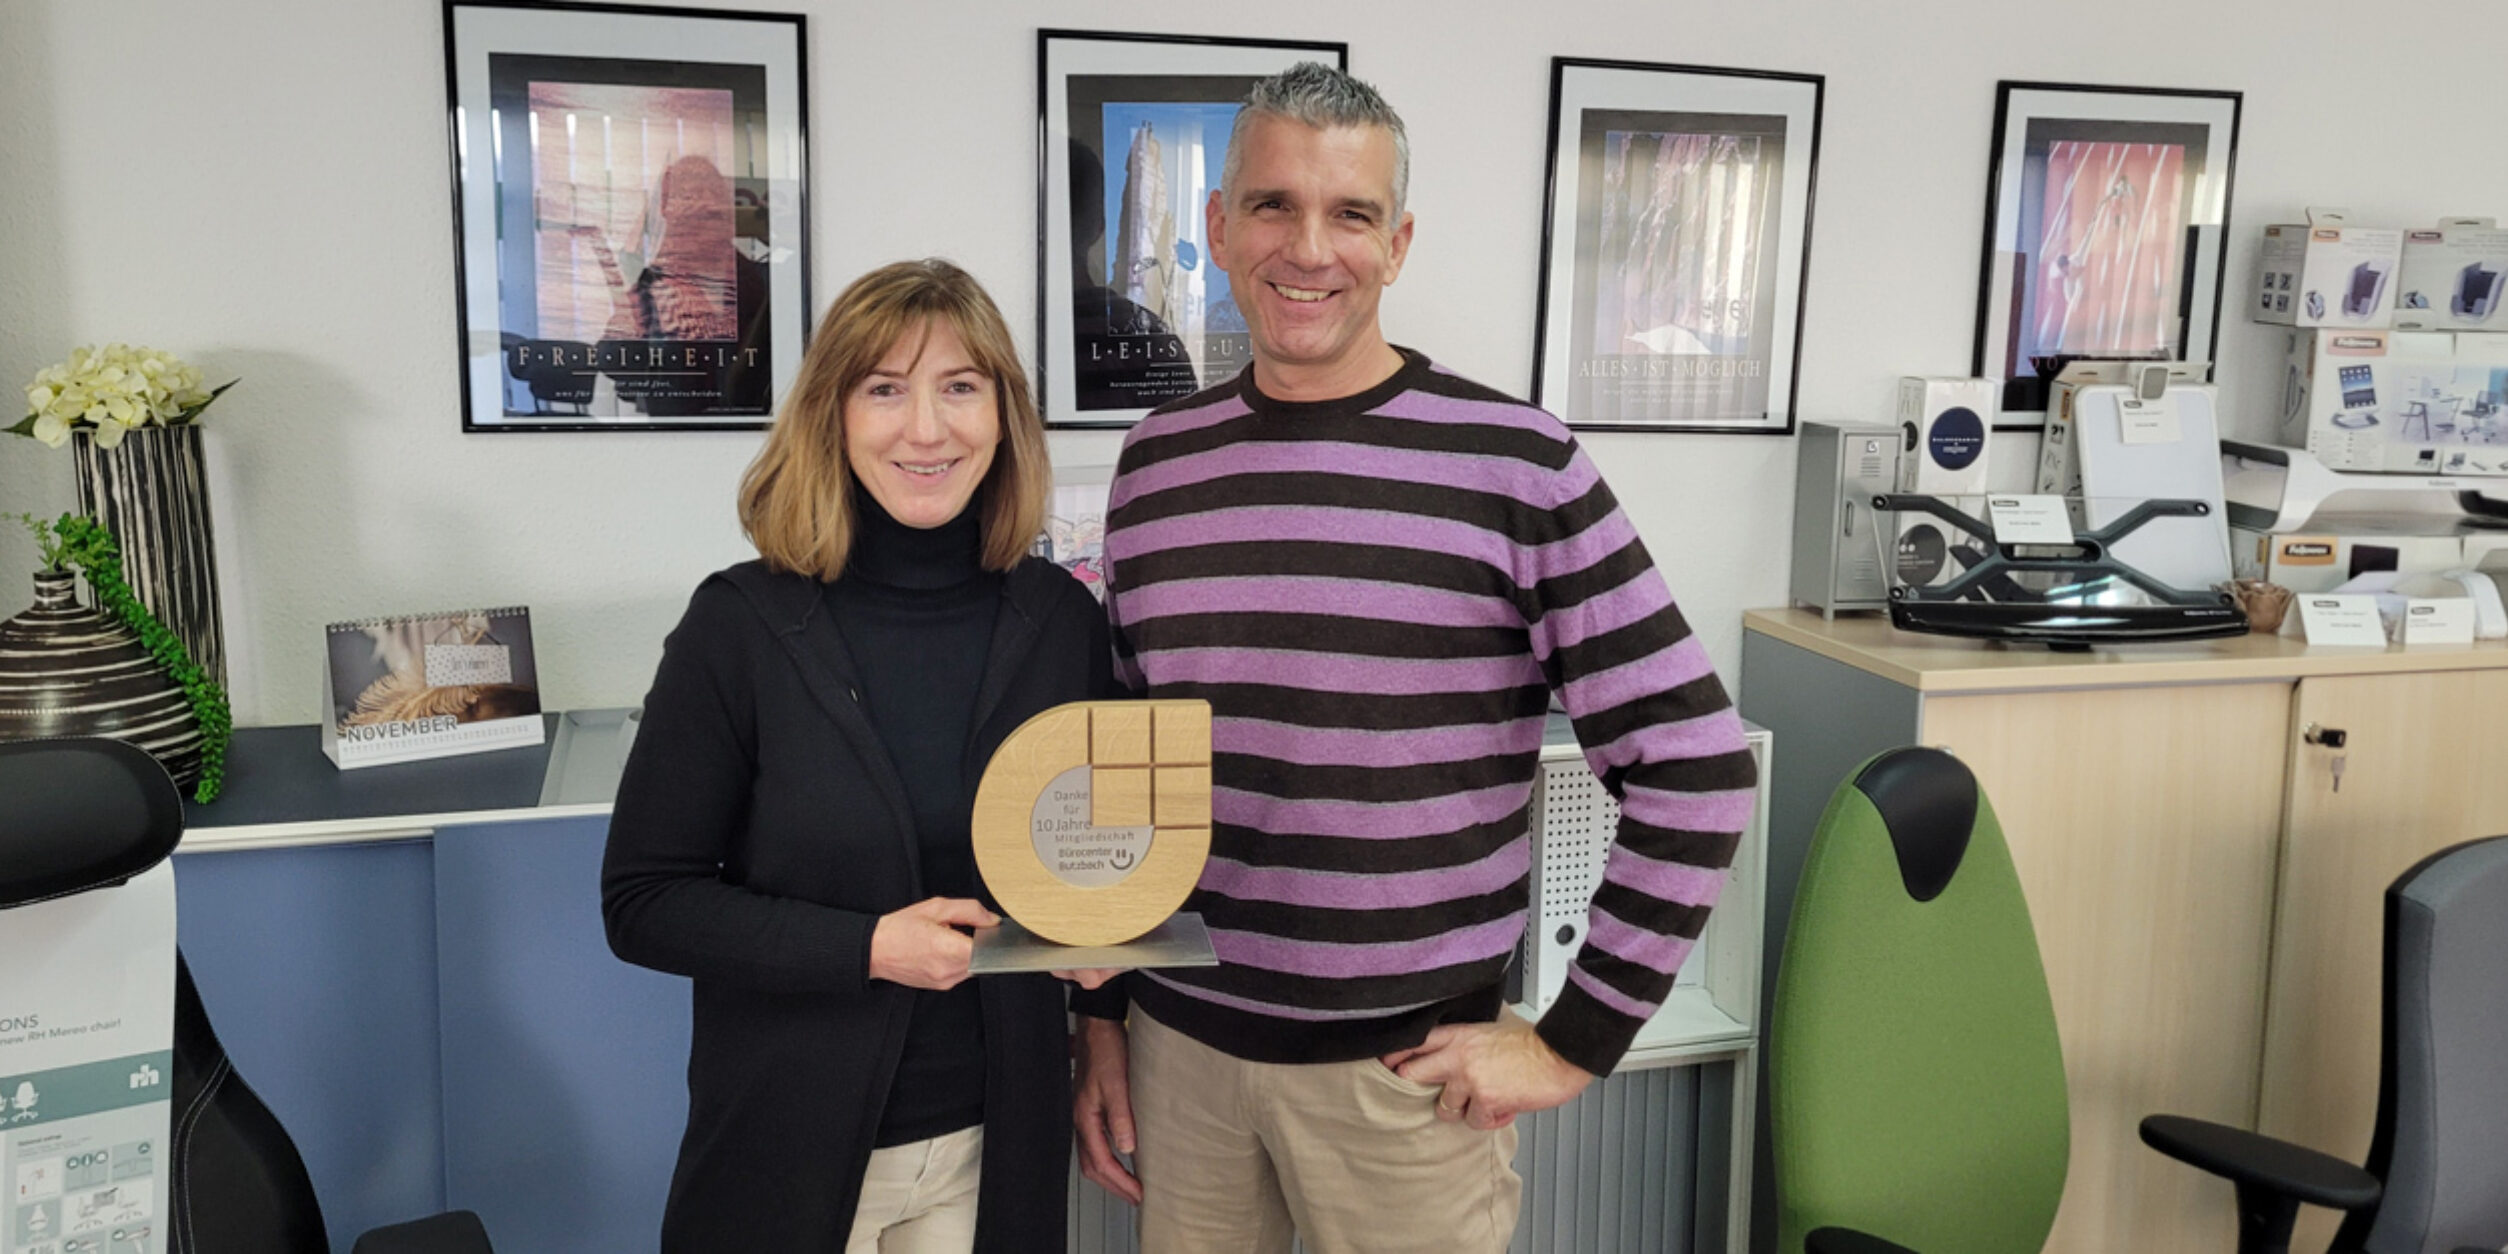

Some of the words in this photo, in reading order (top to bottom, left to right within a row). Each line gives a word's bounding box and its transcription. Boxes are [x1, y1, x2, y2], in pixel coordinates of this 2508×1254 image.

[1578, 359, 1629, 378] ALLES
[1641, 359, 1670, 378] IST
[1681, 357, 1761, 378] MÖGLICH
[2287, 544, 2328, 556] Fellowes
[349, 716, 458, 743] NOVEMBER
[1053, 790, 1089, 802] Danke
[1063, 804, 1080, 815] für
[1036, 819, 1054, 832] 10
[1054, 817, 1092, 832] Jahre
[1055, 831, 1135, 844] Mitgliedschaft
[1058, 846, 1112, 858] Bürocenter
[1058, 859, 1104, 871] Butzbach
